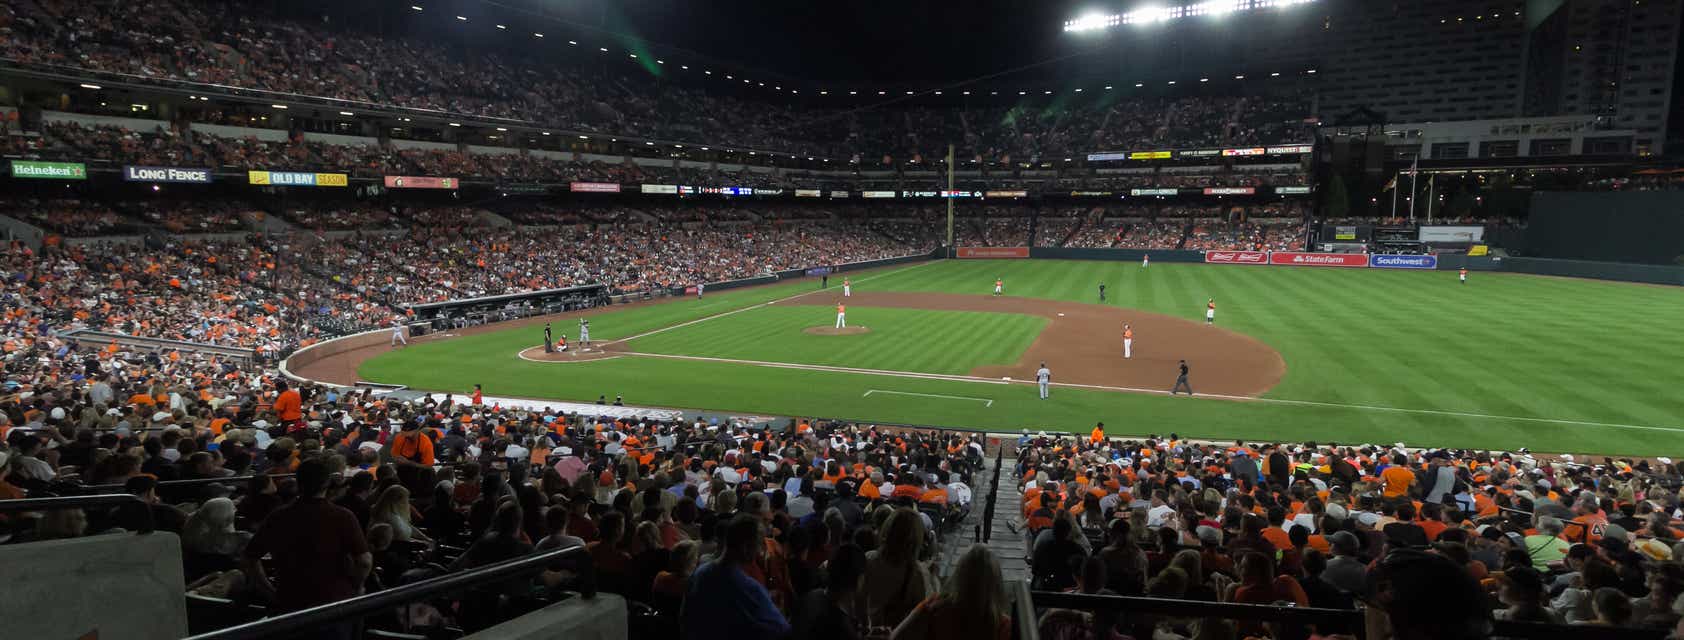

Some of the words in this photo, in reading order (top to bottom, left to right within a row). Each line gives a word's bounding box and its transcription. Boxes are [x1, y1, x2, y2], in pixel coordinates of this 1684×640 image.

[14, 165, 70, 176] Heineken
[130, 167, 165, 180] LONG
[169, 168, 206, 181] FENCE
[272, 173, 293, 184] OLD
[294, 173, 313, 185] BAY
[318, 174, 345, 185] SEASON
[1377, 256, 1423, 266] Southwest
